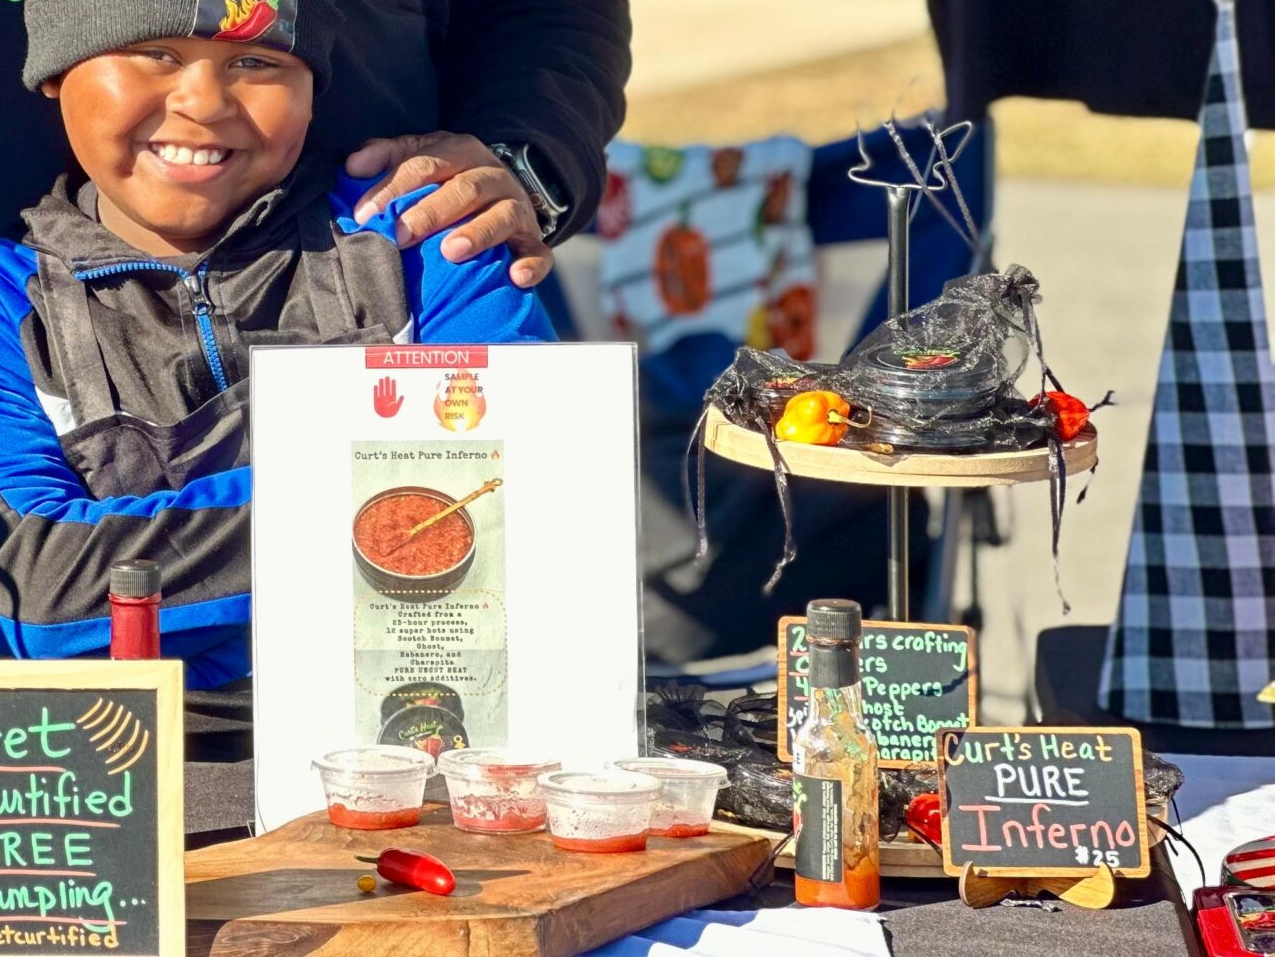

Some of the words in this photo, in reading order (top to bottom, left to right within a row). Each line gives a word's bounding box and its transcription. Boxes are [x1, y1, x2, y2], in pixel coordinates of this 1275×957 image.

[383, 350, 470, 365] ATTENTION
[444, 373, 480, 381] SAMPLE
[445, 386, 457, 394] AT
[458, 386, 484, 394] YOUR
[444, 399, 468, 407] OWN
[445, 412, 465, 420] RISK
[354, 451, 388, 460] Curt's
[390, 450, 415, 460] Heat
[418, 450, 443, 460] Pure
[445, 450, 488, 460] Inferno
[449, 627, 475, 635] using
[891, 631, 967, 672] crafting
[862, 676, 943, 701] Peppers
[861, 699, 904, 716] host
[944, 733, 1032, 766] Curt's
[1040, 734, 1113, 763] Heat
[994, 764, 1088, 798] PURE
[958, 803, 1136, 852] Inferno
